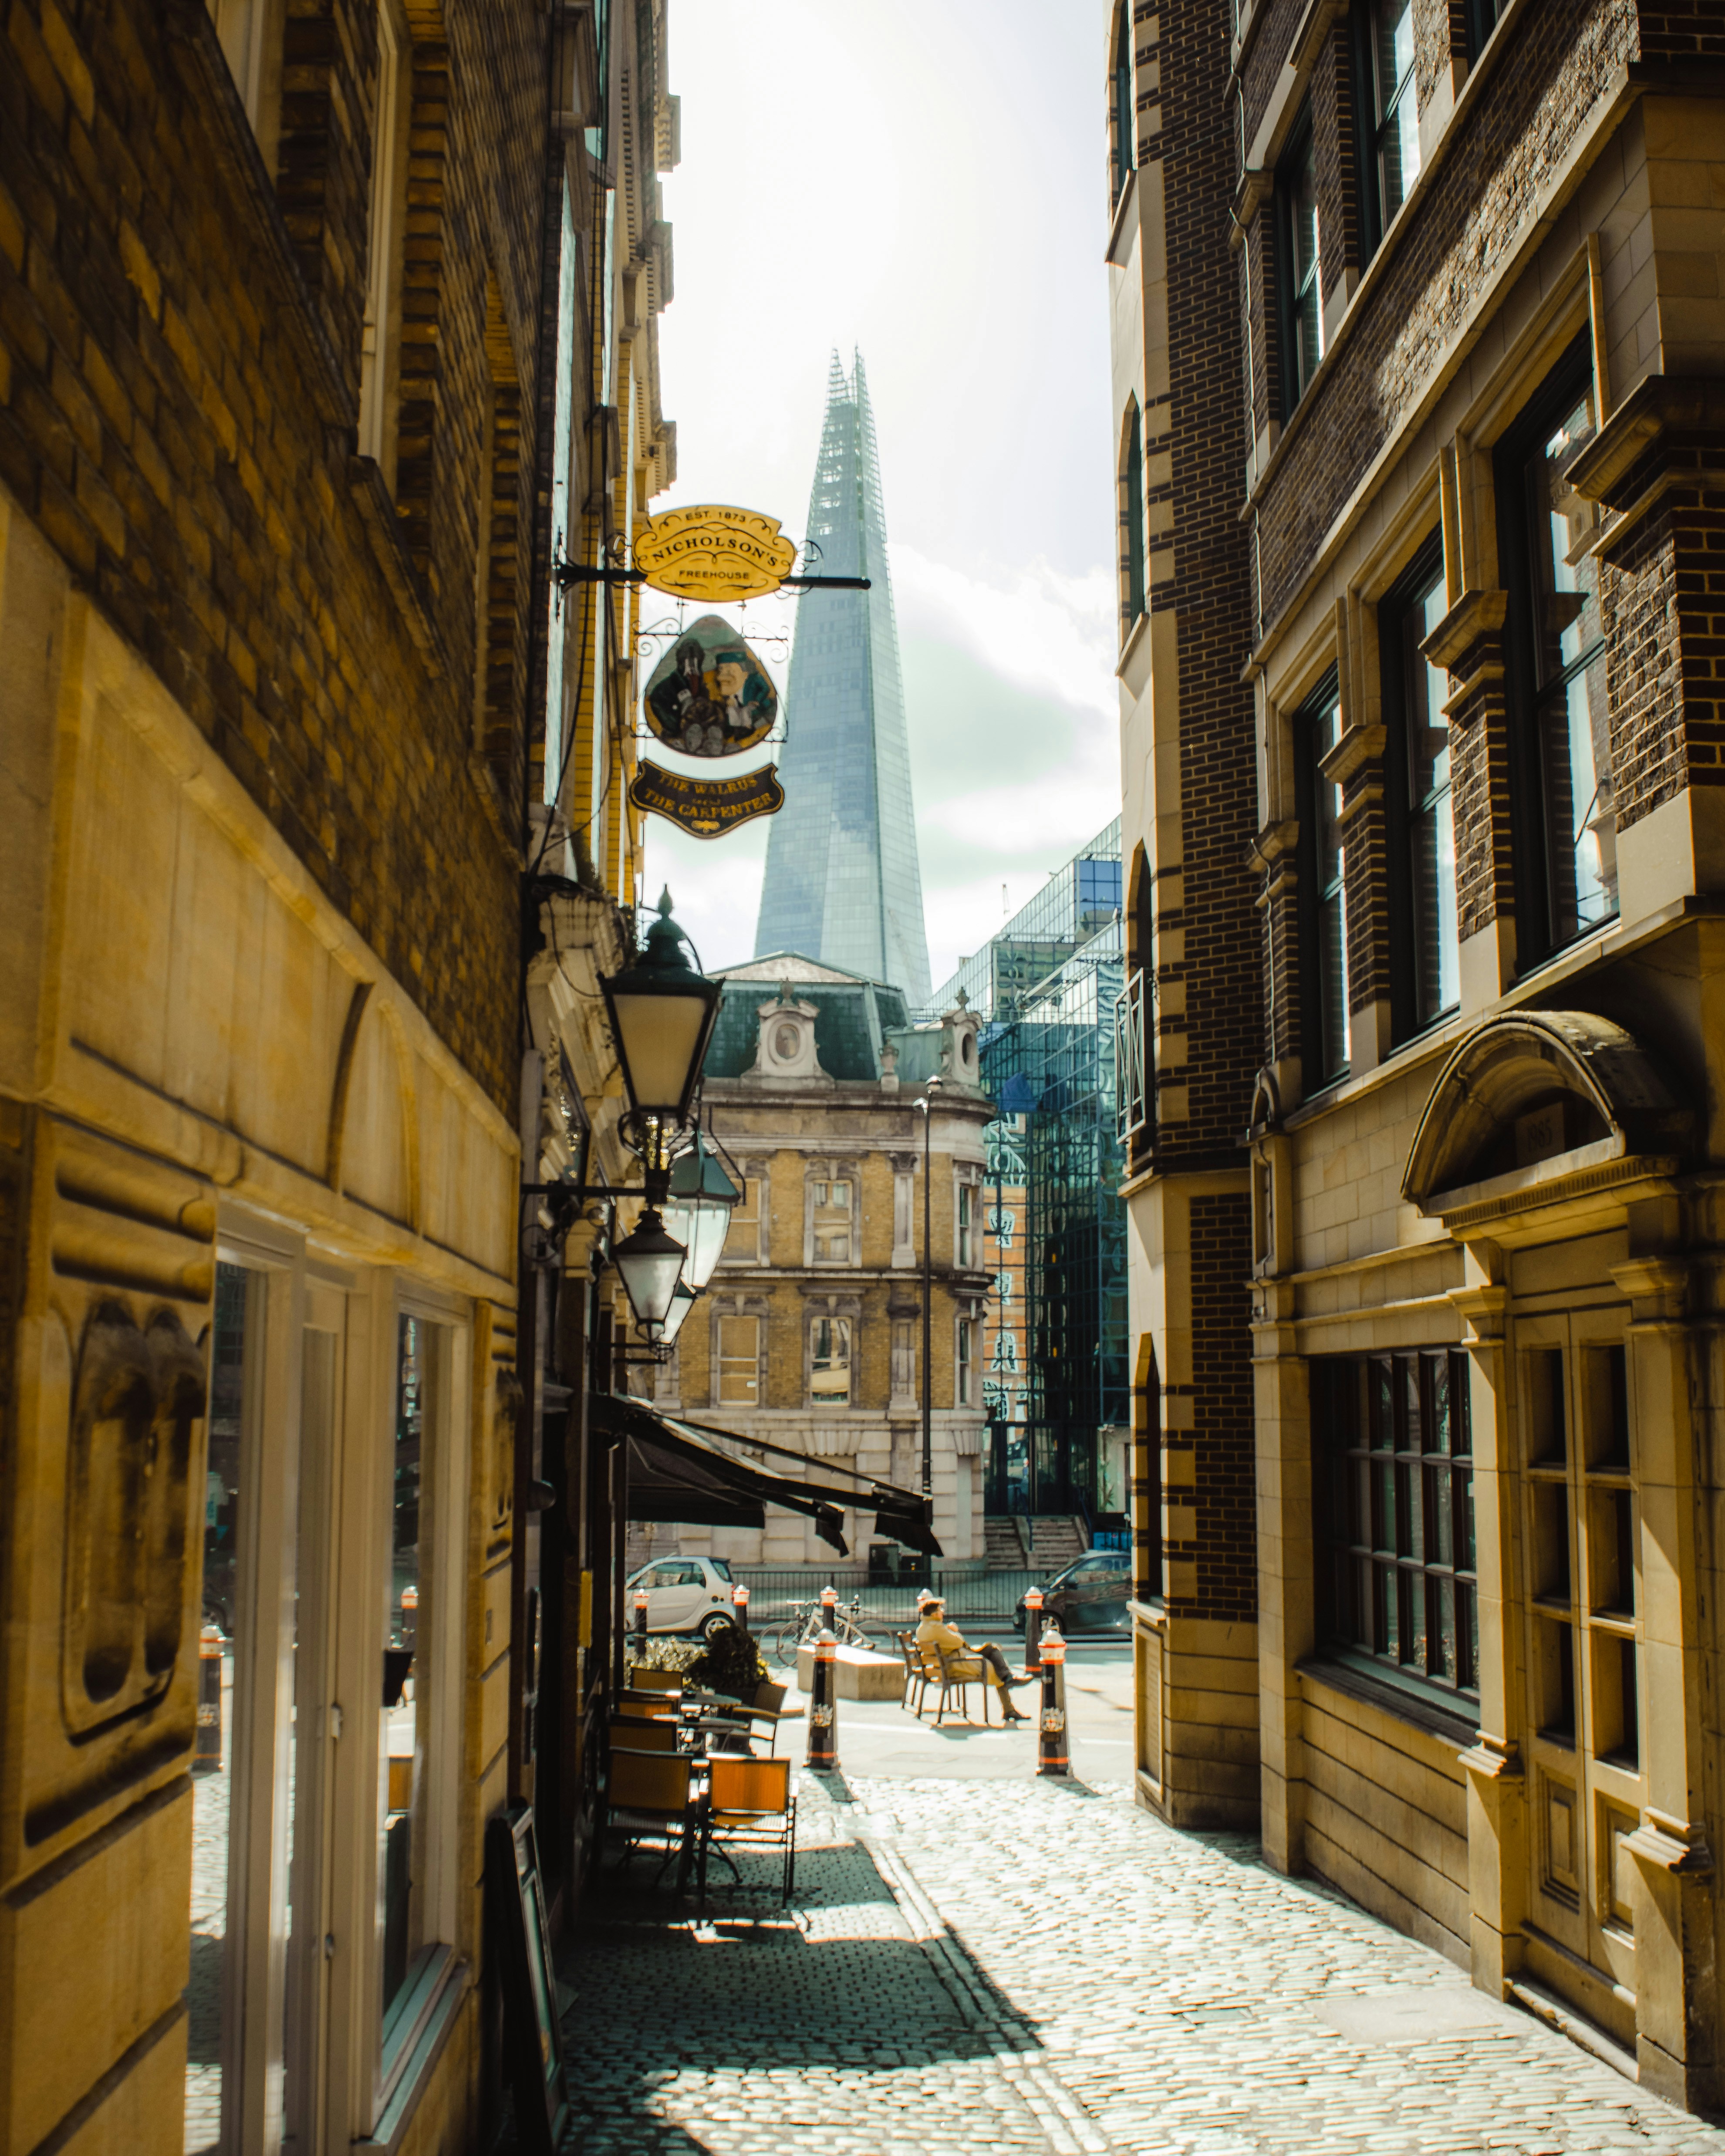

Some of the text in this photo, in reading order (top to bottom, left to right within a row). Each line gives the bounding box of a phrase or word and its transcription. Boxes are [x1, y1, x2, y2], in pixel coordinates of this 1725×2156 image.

[685, 510, 746, 522] EST. 1873
[653, 536, 777, 567] NICHOLSON'S
[679, 570, 750, 580] FREEHOUSE
[659, 773, 757, 795] THE WALRUS
[645, 788, 773, 819] THE CARPENTER
